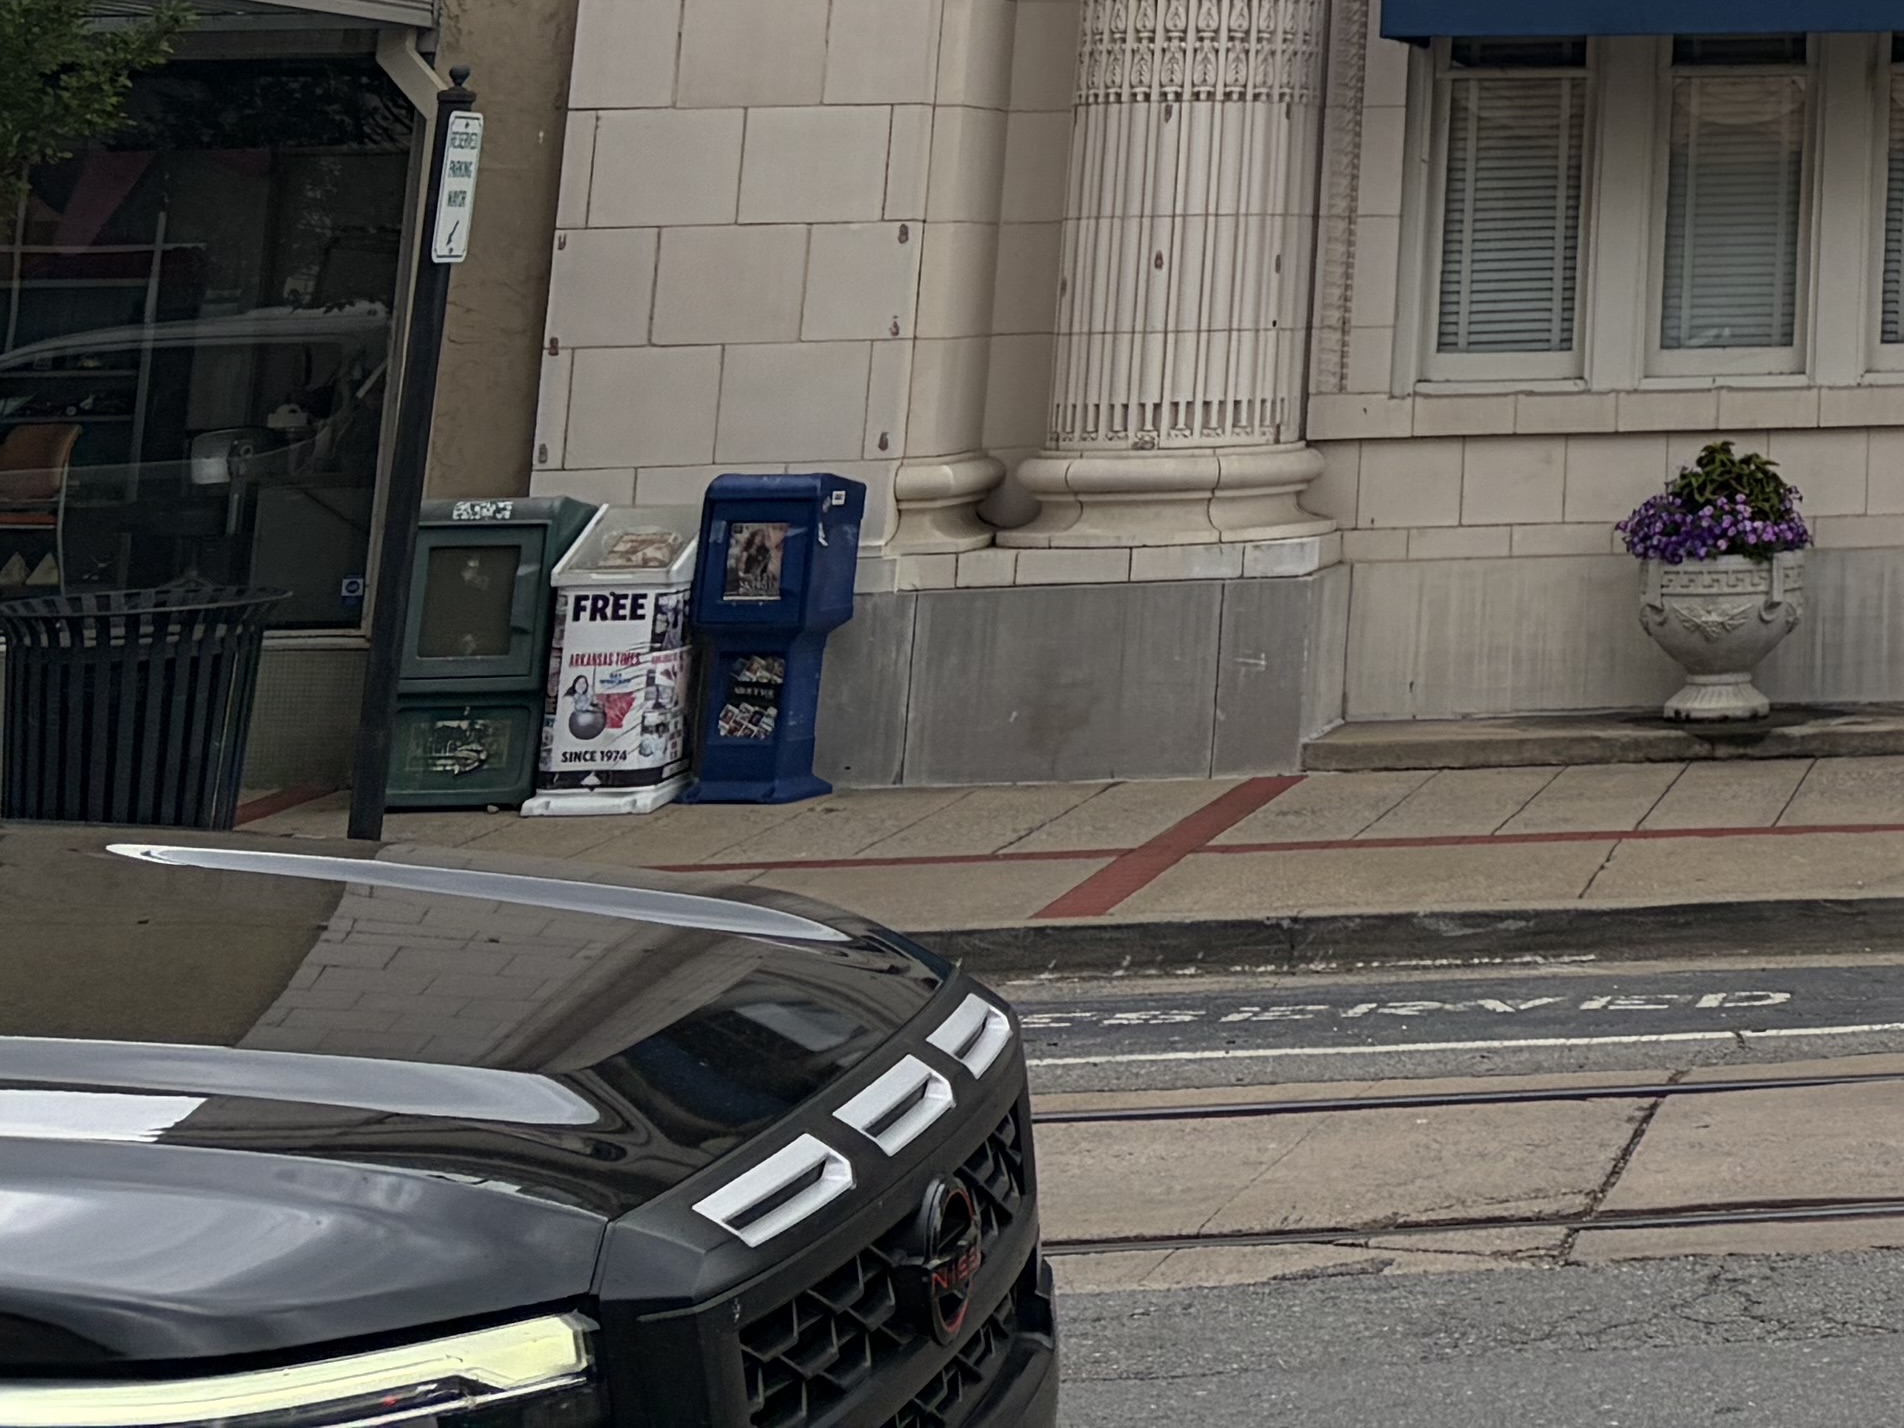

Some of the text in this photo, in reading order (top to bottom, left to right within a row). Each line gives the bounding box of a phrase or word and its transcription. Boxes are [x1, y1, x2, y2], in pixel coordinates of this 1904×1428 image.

[572, 593, 648, 622] FREE
[568, 652, 614, 668] ARKANSAS
[561, 749, 628, 763] SINCE 1974
[1019, 991, 1792, 1028] ESERVED
